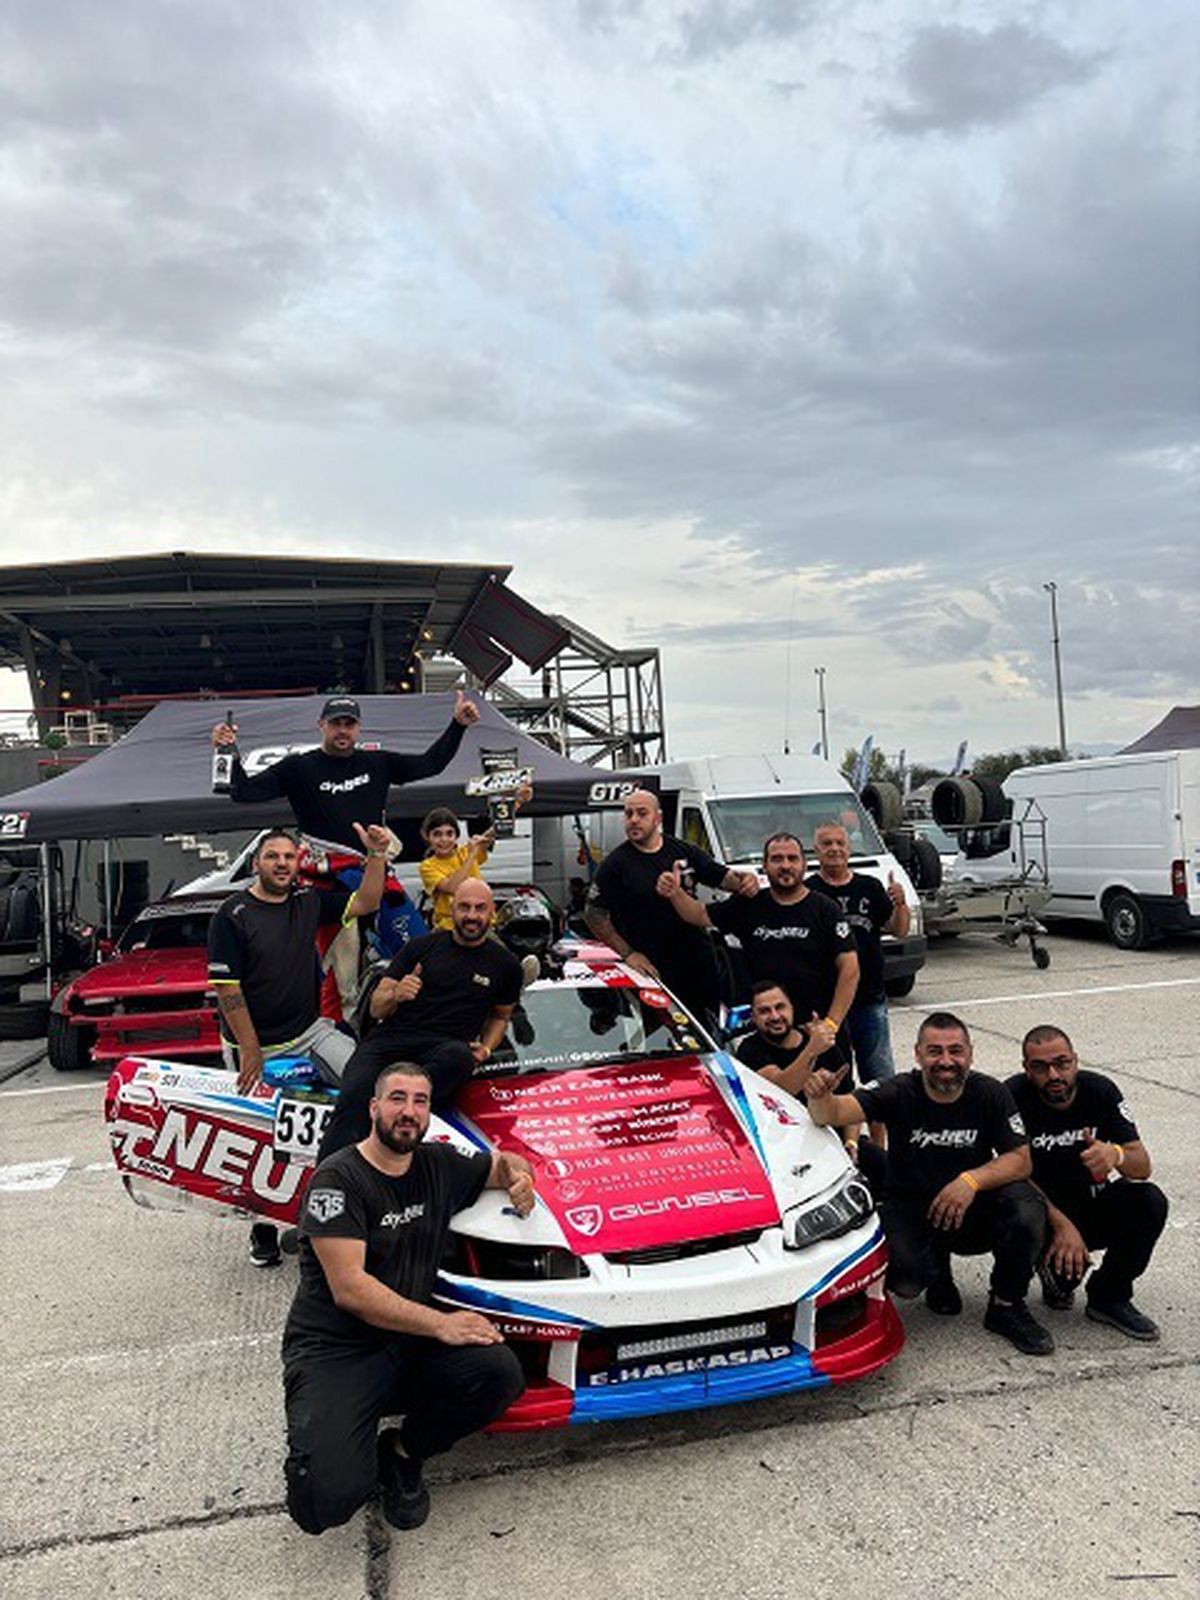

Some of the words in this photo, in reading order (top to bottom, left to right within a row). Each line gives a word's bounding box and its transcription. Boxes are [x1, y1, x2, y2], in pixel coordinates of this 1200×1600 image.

[496, 803, 509, 819] 3
[514, 1084, 562, 1098] NEAR
[568, 1079, 612, 1092] EAST
